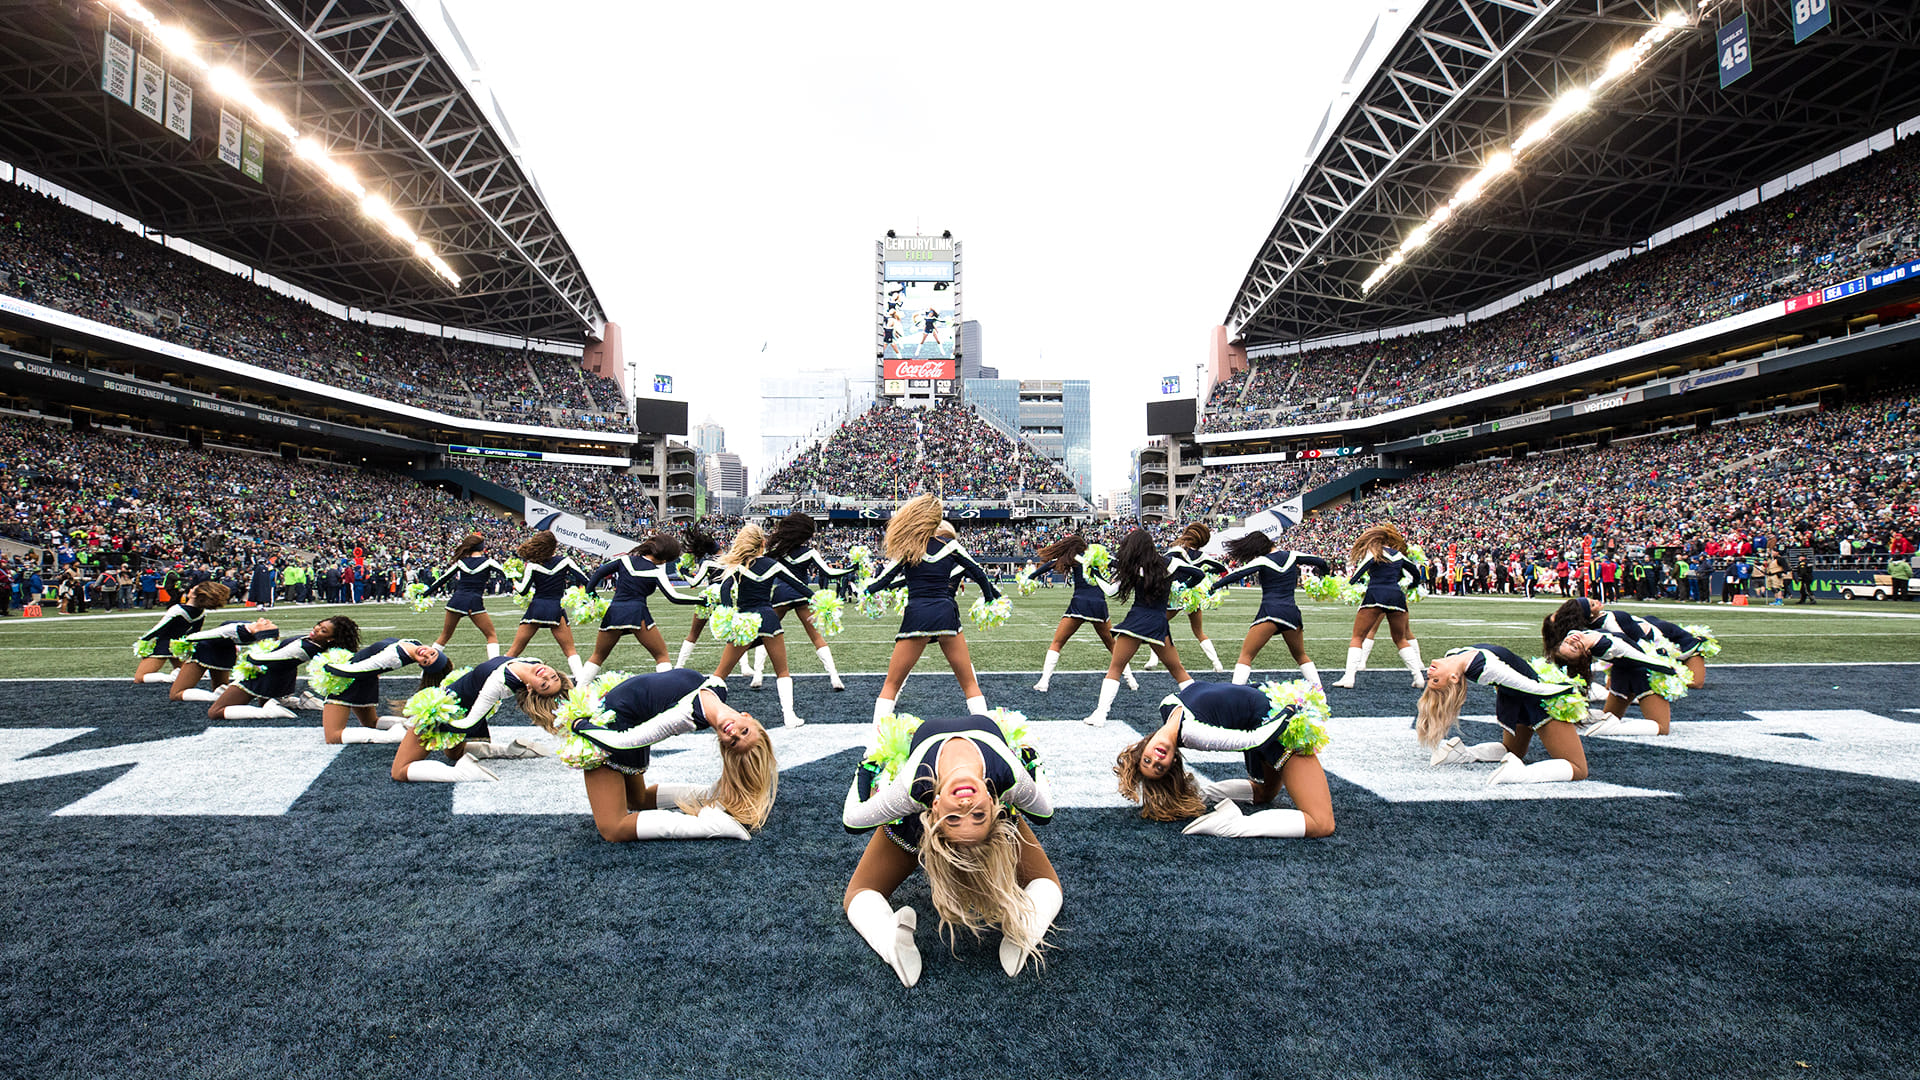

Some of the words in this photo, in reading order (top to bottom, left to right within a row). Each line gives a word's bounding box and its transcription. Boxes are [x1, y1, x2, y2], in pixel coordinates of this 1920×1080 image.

[1795, 0, 1826, 25] 80
[1721, 37, 1748, 71] 45
[886, 237, 953, 250] CENTURYLINK
[905, 251, 933, 260] FIELD
[1871, 275, 1882, 287] 1st
[1896, 267, 1906, 279] 10
[1825, 287, 1842, 300] SEA
[1848, 283, 1855, 294] 6
[1786, 299, 1797, 312] SF
[1807, 295, 1813, 306] 0
[26, 363, 51, 377] CHUCK
[51, 369, 70, 381] KNOX
[895, 361, 946, 378] Coca-Cola
[103, 380, 115, 390] 96
[115, 383, 137, 395] CORTEZ
[137, 387, 165, 401] KENNEDY
[192, 399, 201, 408] 71
[1583, 397, 1624, 414] verizon
[257, 412, 272, 423] RING
[272, 416, 281, 424] OF
[280, 418, 299, 427] HONOR
[555, 525, 579, 540] Insure
[578, 533, 611, 550] Carefully
[27, 606, 41, 617] 20
